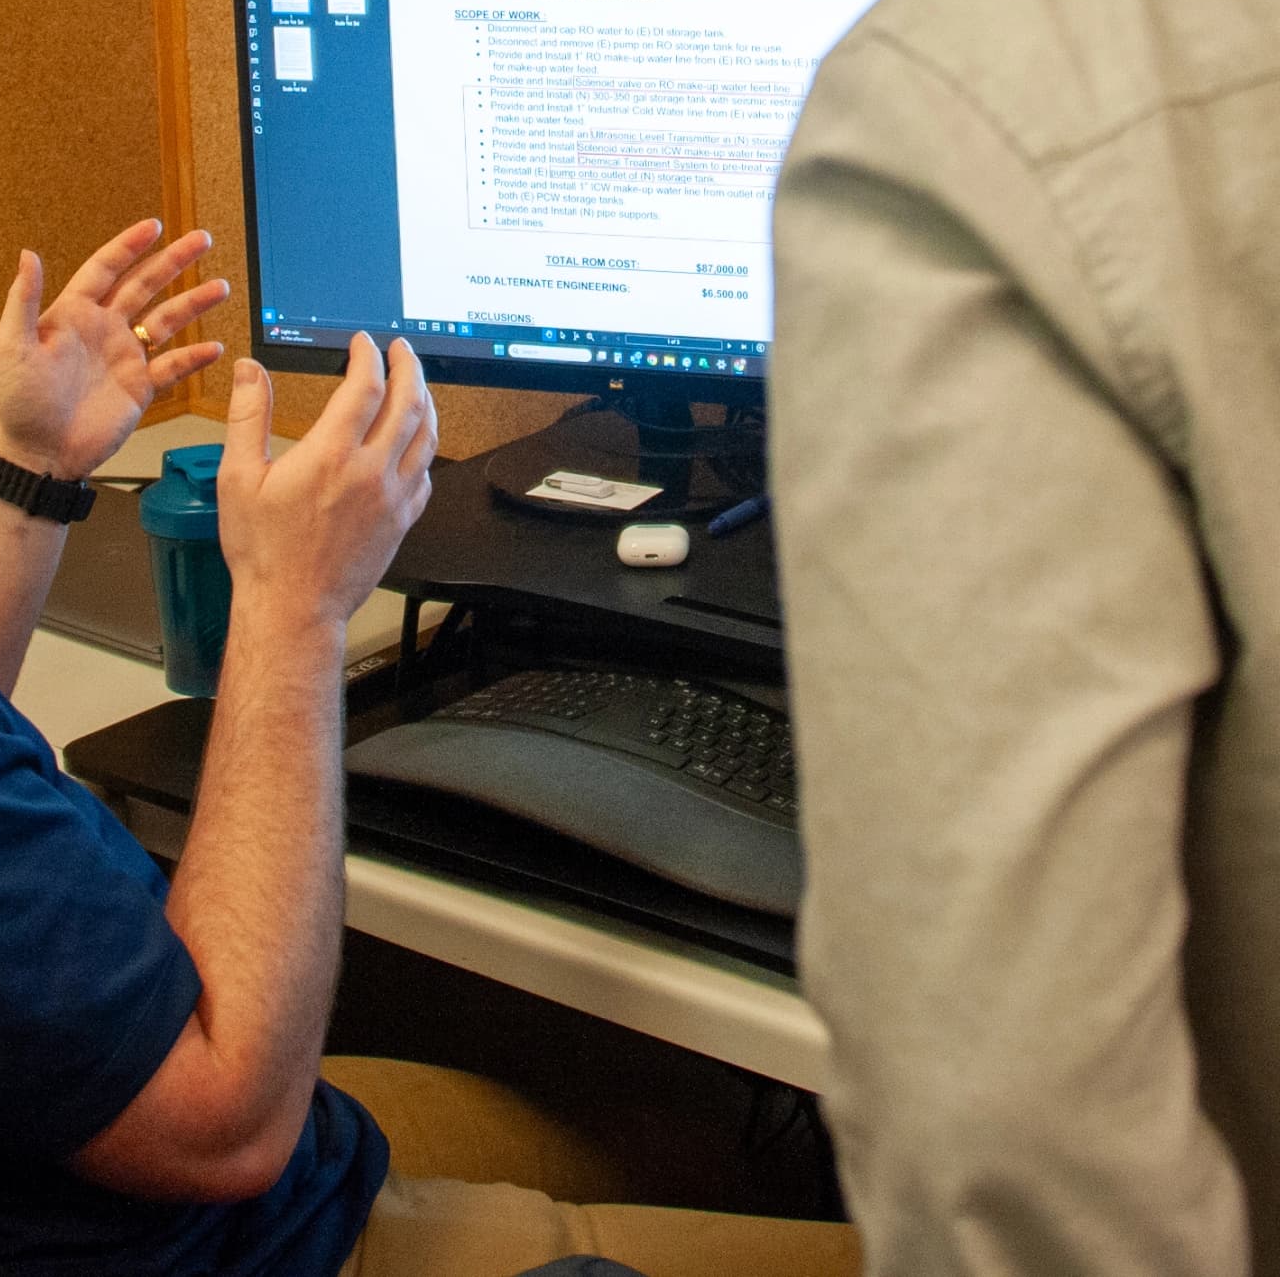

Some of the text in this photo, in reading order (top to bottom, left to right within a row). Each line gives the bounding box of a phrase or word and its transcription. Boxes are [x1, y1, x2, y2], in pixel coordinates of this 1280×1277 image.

[454, 9, 541, 20] SCOPE OF WORK
[487, 23, 701, 38] Disconnect and cap RO water (E) storage
[488, 36, 537, 46] Disconnect
[540, 37, 557, 47] and
[596, 38, 611, 50] (E)
[612, 41, 639, 51] pump
[656, 40, 672, 49] RO
[675, 41, 709, 52] storage
[712, 41, 732, 51] tank
[735, 41, 748, 51] for
[488, 49, 808, 68] Provide and Install RO make-up water from (E) RO skids (E)
[492, 61, 573, 74] for make-up water
[489, 74, 746, 92] Provide and Install Solenoid valve RO make-up water
[490, 88, 524, 98] Provide
[526, 89, 544, 98] and
[546, 89, 572, 99] Install
[575, 90, 590, 102] (N)
[649, 93, 684, 105] storage
[687, 94, 706, 103] tank
[710, 94, 728, 104] with
[731, 95, 766, 105] seismic
[490, 101, 772, 119] Provide and Install Industrial Cold Water from (E) valve
[495, 112, 560, 125] make up water
[492, 126, 525, 137] Provide
[528, 127, 545, 137] and
[548, 128, 574, 138] Install
[577, 131, 588, 139] an
[639, 131, 664, 141] Level
[668, 132, 719, 143] Transmitter
[734, 134, 748, 146] (N)
[752, 135, 787, 147] storage
[492, 139, 526, 150] Provide
[529, 141, 546, 150] and
[548, 141, 574, 151] Install
[576, 142, 617, 153] Solenoid
[620, 144, 643, 154] valve
[684, 146, 725, 159] make-up
[727, 148, 752, 158] water
[492, 152, 526, 163] Provide
[529, 154, 546, 164] and
[548, 154, 575, 165] Install
[577, 156, 621, 166] Chemical
[722, 161, 762, 174] pre-treat
[493, 165, 531, 176] Reinstall
[535, 167, 549, 178] (E)
[550, 169, 576, 179] pump
[578, 169, 598, 178] onto
[640, 170, 654, 182] (N)
[657, 171, 692, 183] storage
[493, 177, 527, 188] Provide
[530, 179, 547, 189] and
[549, 180, 576, 190] Install
[613, 183, 653, 196] make-up
[656, 185, 680, 195] water
[703, 187, 724, 197] from
[498, 190, 623, 205] both (E) PCW storage tanks
[494, 203, 528, 213] Provide
[531, 204, 548, 214] and
[550, 205, 577, 215] Install
[580, 206, 594, 218] (N)
[596, 207, 616, 219] pipe
[496, 215, 520, 225] Label
[546, 255, 749, 275] TOTAL ROM COST: $87,000.00
[494, 277, 554, 289] ALTERNATE
[557, 280, 631, 293] ENGINEERING:
[702, 288, 749, 300] $6,500.00
[467, 311, 535, 324] EXCLUSIONS:
